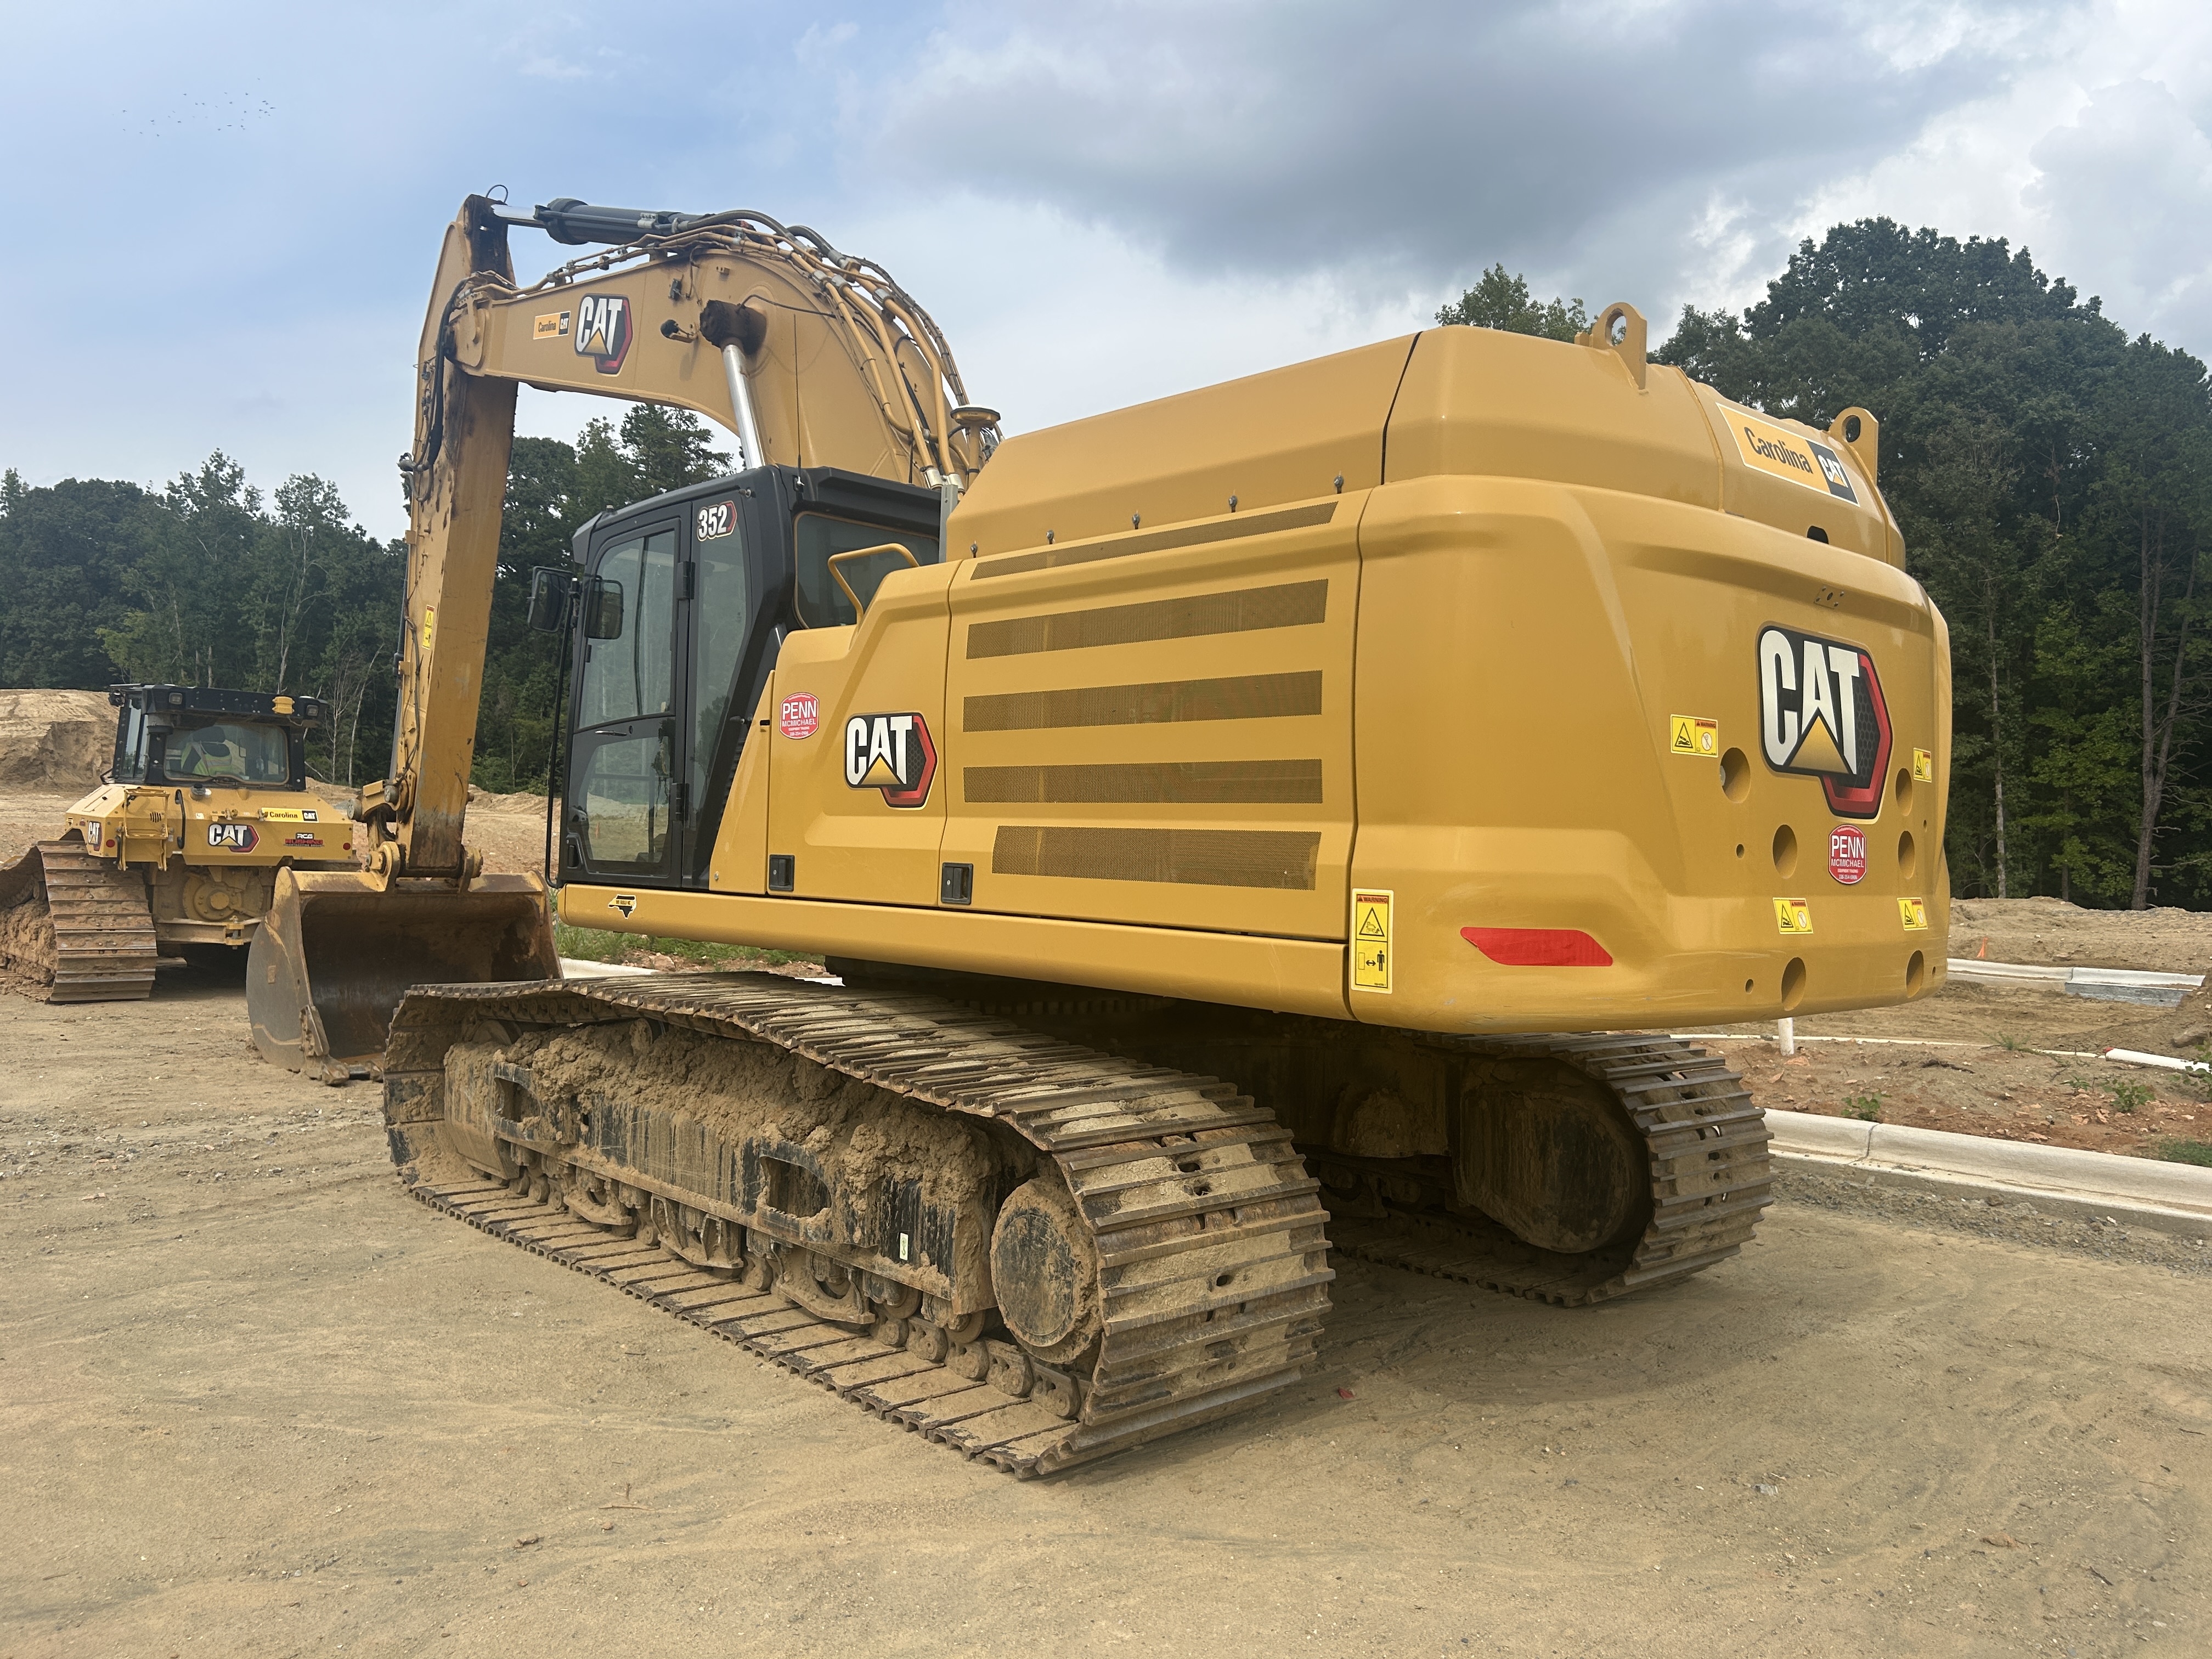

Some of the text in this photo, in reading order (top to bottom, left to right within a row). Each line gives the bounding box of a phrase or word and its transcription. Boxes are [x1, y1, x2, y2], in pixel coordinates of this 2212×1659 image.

[538, 318, 569, 332] Carolina CAT
[576, 296, 623, 356] CAT
[1744, 426, 1849, 488] Carolina CAT
[698, 504, 727, 538] 352
[782, 699, 817, 720] PENN
[1760, 630, 1860, 775] CAT
[782, 719, 816, 727] MCMICHAEL
[847, 715, 912, 786] CAT
[88, 821, 100, 844] CAT
[209, 824, 247, 847] CAT
[1831, 835, 1865, 859] PENN
[1831, 859, 1865, 868] MCMICHAEL
